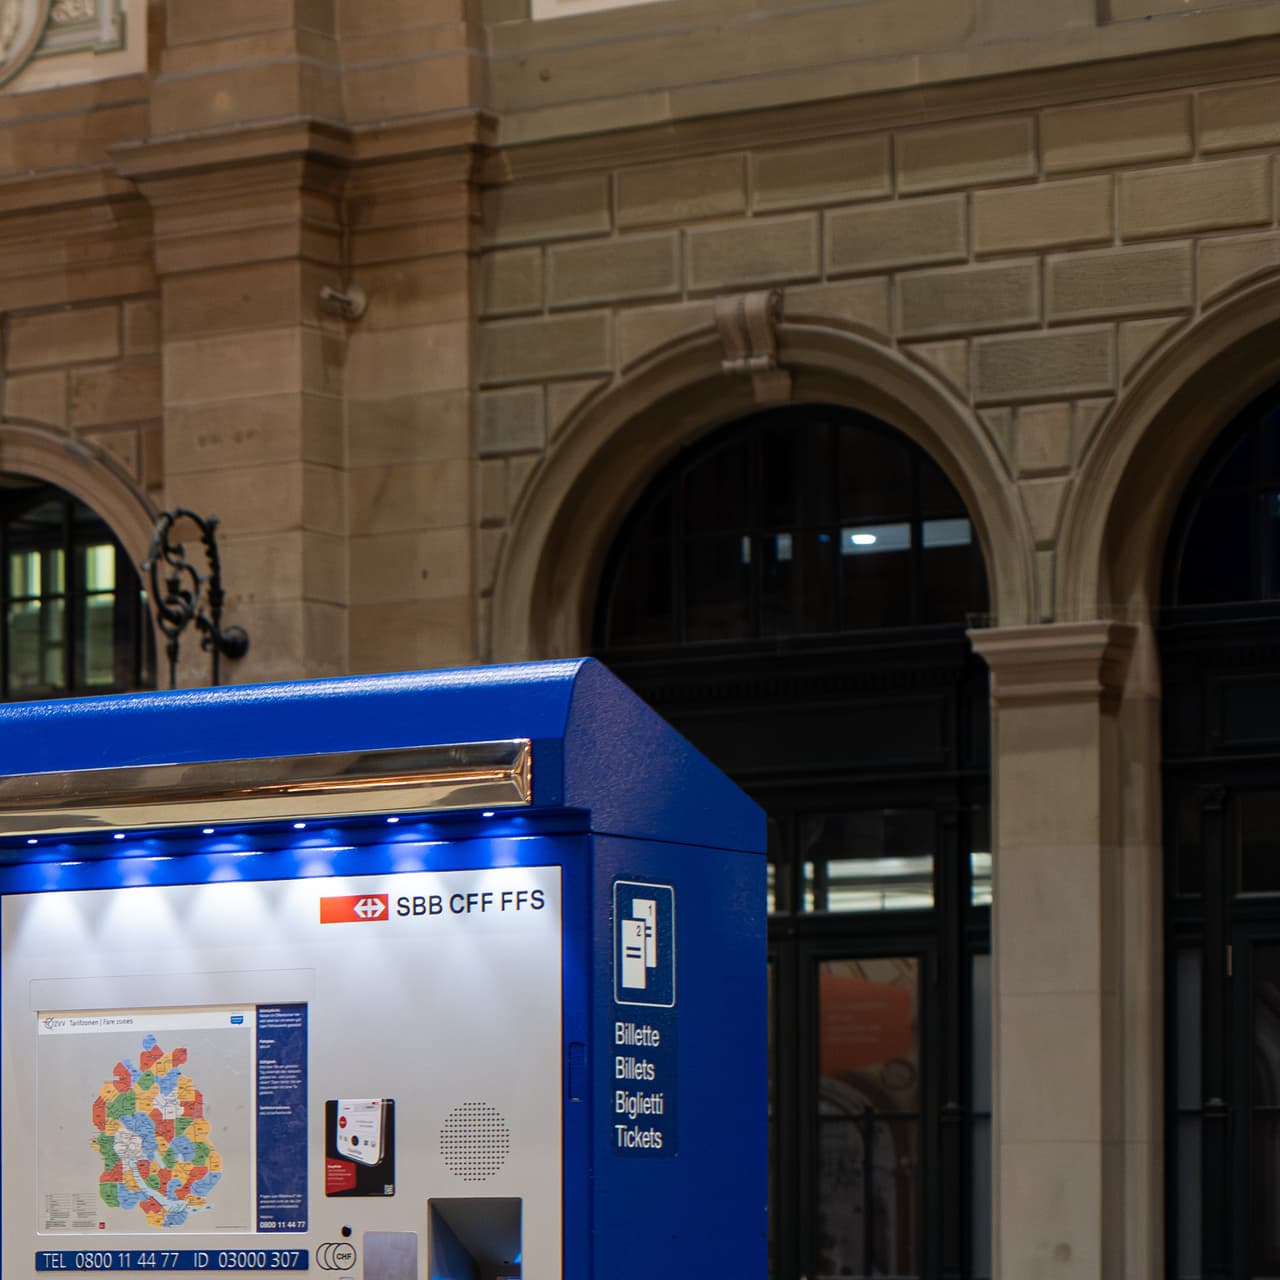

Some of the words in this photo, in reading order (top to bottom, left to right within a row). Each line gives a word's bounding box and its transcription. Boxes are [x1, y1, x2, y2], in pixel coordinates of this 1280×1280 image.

[397, 895, 443, 916] SBB
[450, 892, 493, 913] CFF
[501, 889, 544, 911] FFS
[615, 1022, 660, 1046] Billette
[615, 1056, 655, 1080] Billets
[615, 1090, 663, 1119] Biglietti
[615, 1125, 662, 1148] Tickets
[43, 1254, 66, 1268] TEL
[76, 1253, 112, 1268] 0800
[120, 1253, 130, 1267] 11
[138, 1253, 156, 1268] 44
[162, 1252, 179, 1267] 77
[194, 1252, 208, 1267] ID
[219, 1252, 266, 1267] 03000
[271, 1251, 299, 1267] 307
